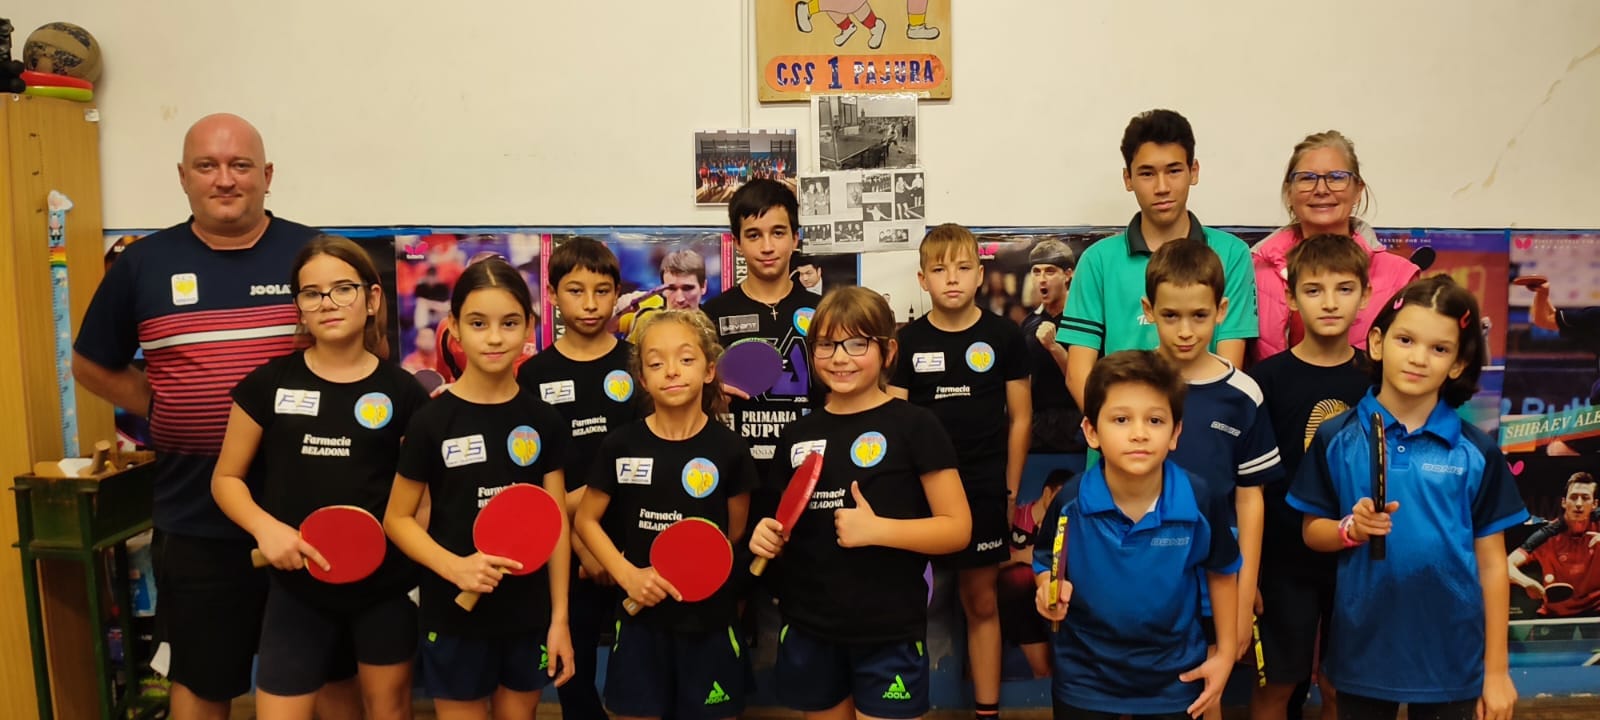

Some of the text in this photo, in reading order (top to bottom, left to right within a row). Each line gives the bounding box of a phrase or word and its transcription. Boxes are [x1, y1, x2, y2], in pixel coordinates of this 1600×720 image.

[776, 56, 935, 89] CSS 1 PAJURA
[250, 284, 291, 296] JOOLA
[742, 411, 797, 423] PRIMARIA
[1506, 416, 1571, 439] SHIBAEV
[303, 433, 352, 447] Farmacia
[301, 445, 350, 457] BELADONA
[619, 463, 651, 477] FS
[811, 488, 846, 499] armacia
[639, 508, 683, 521] Farmacia
[638, 520, 673, 532] BELADO
[882, 691, 912, 700] JOOLA
